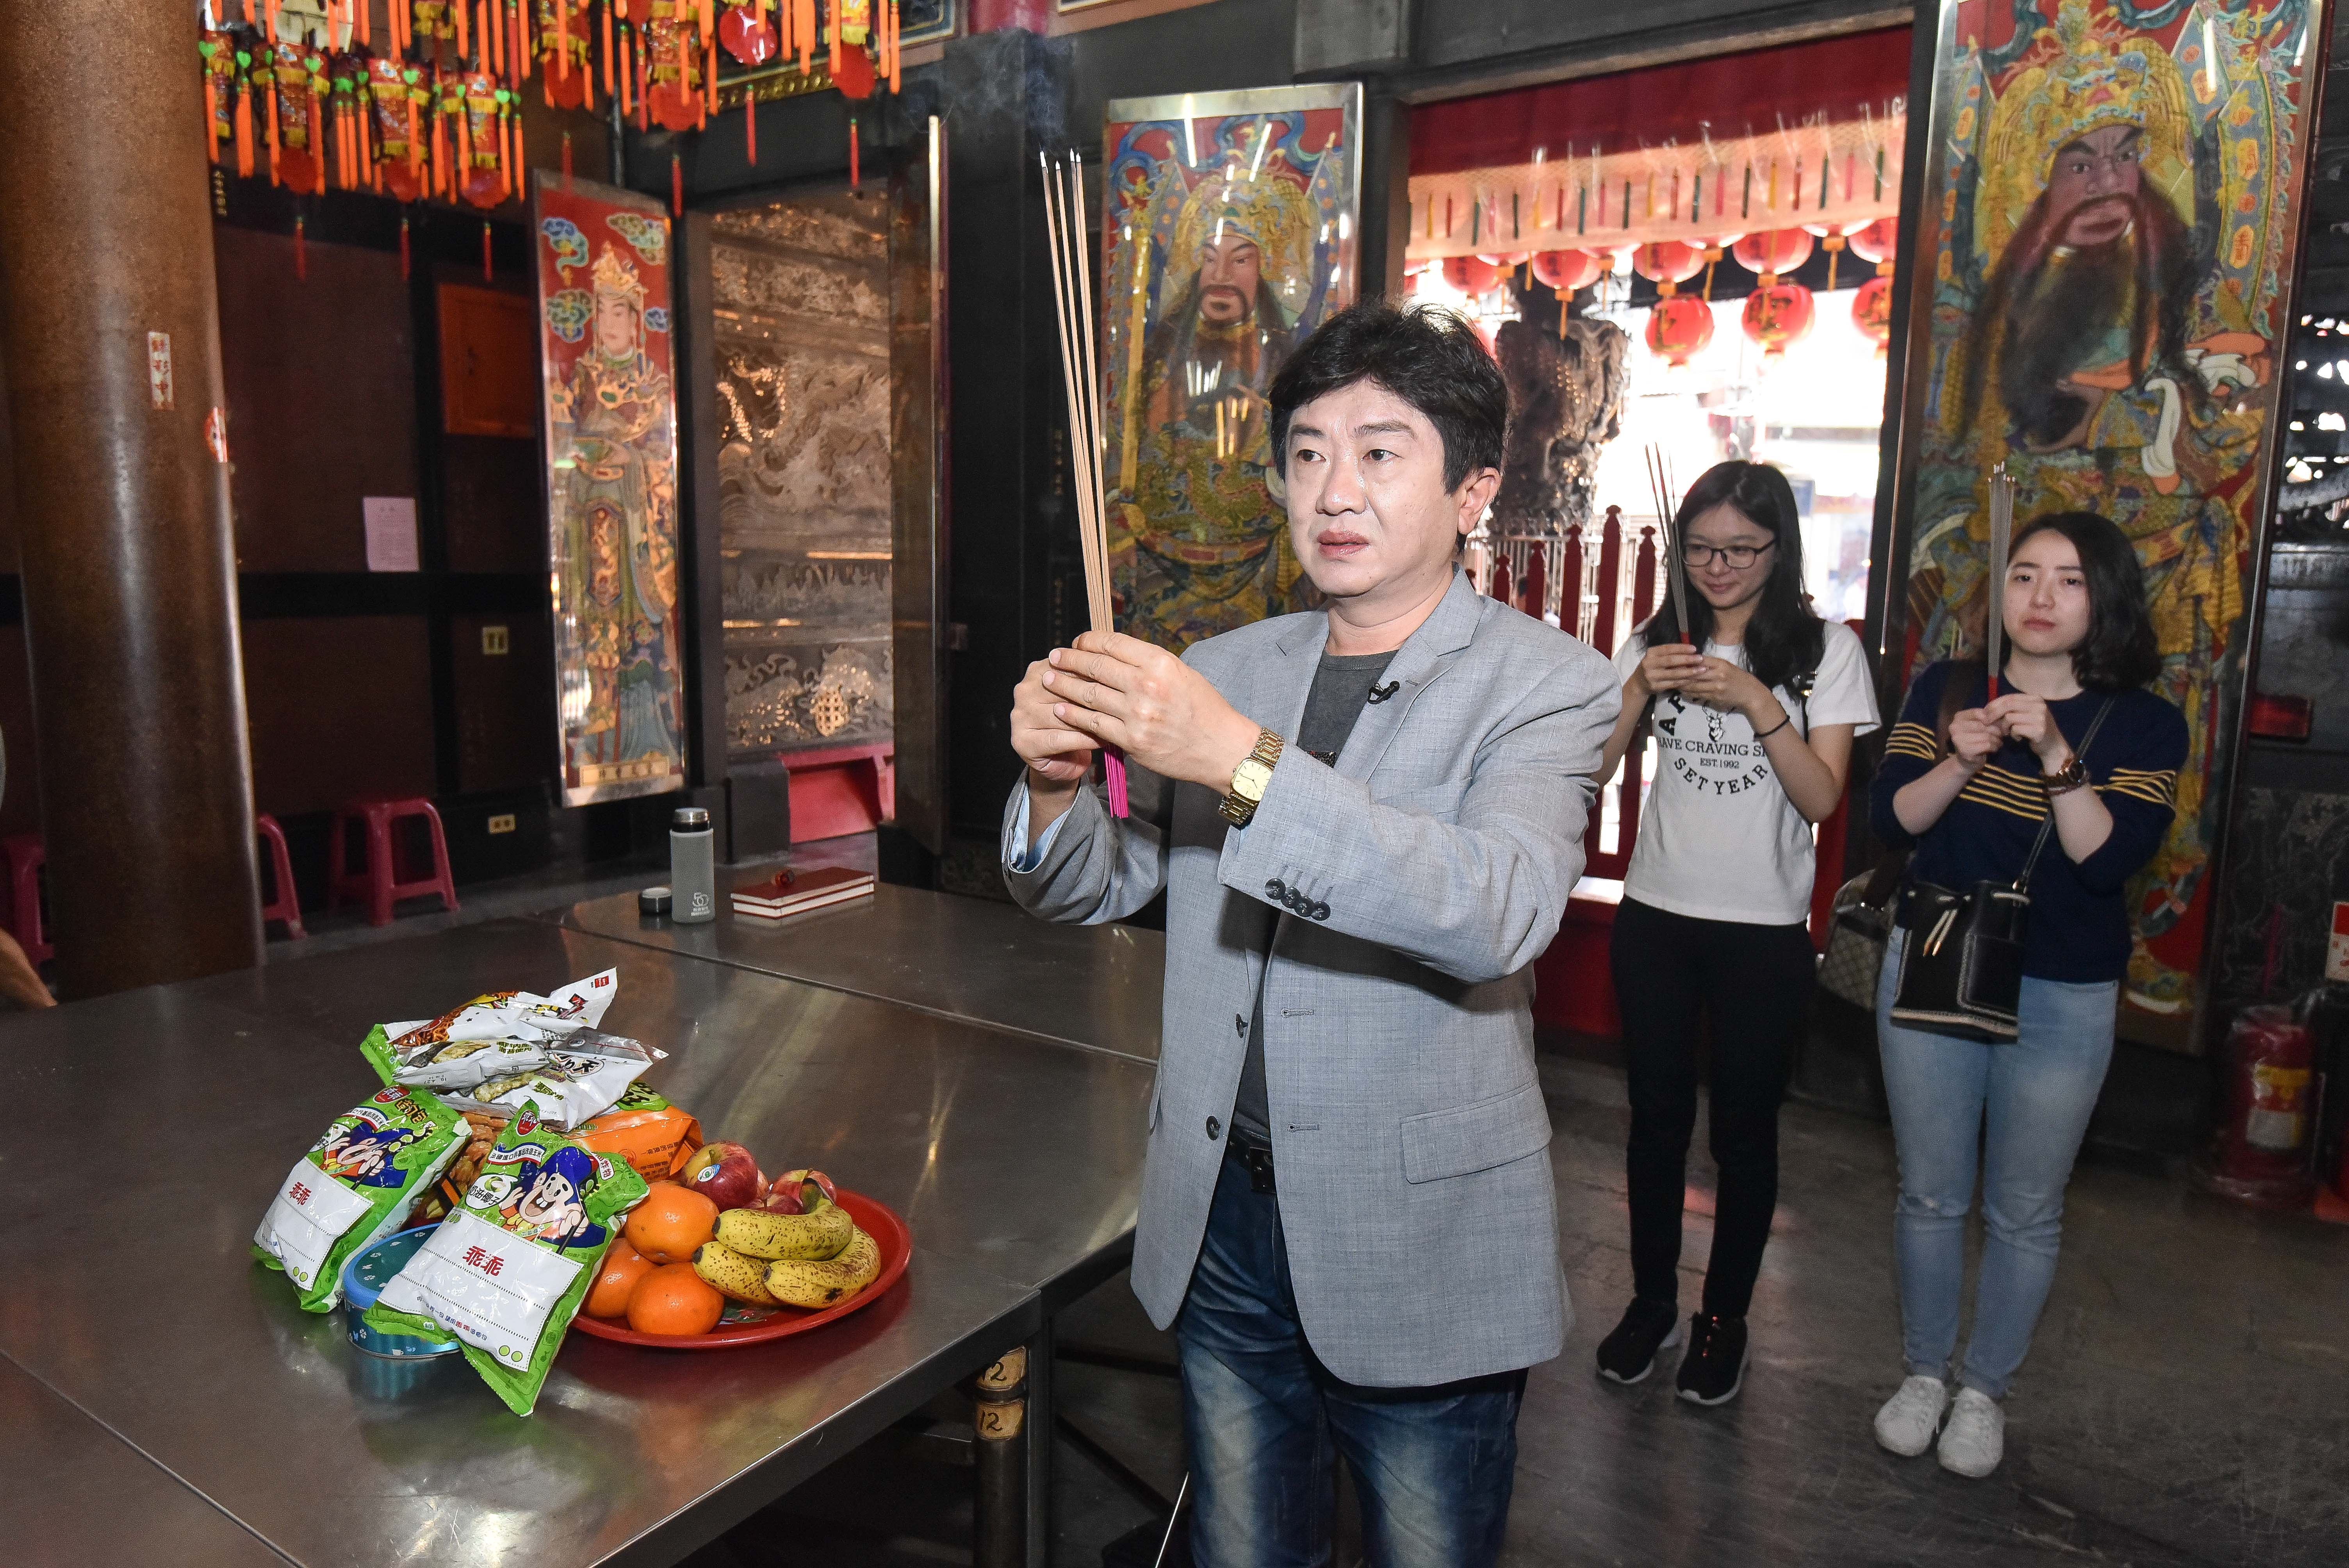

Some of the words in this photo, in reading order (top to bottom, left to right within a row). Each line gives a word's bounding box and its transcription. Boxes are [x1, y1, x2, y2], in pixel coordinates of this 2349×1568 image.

[1685, 740, 1748, 756] CRAVING
[289, 1181, 312, 1205] 乖乖
[469, 1185, 500, 1205] 奶油椰子
[462, 1245, 504, 1276] 乖乖
[980, 1411, 1003, 1431] 12
